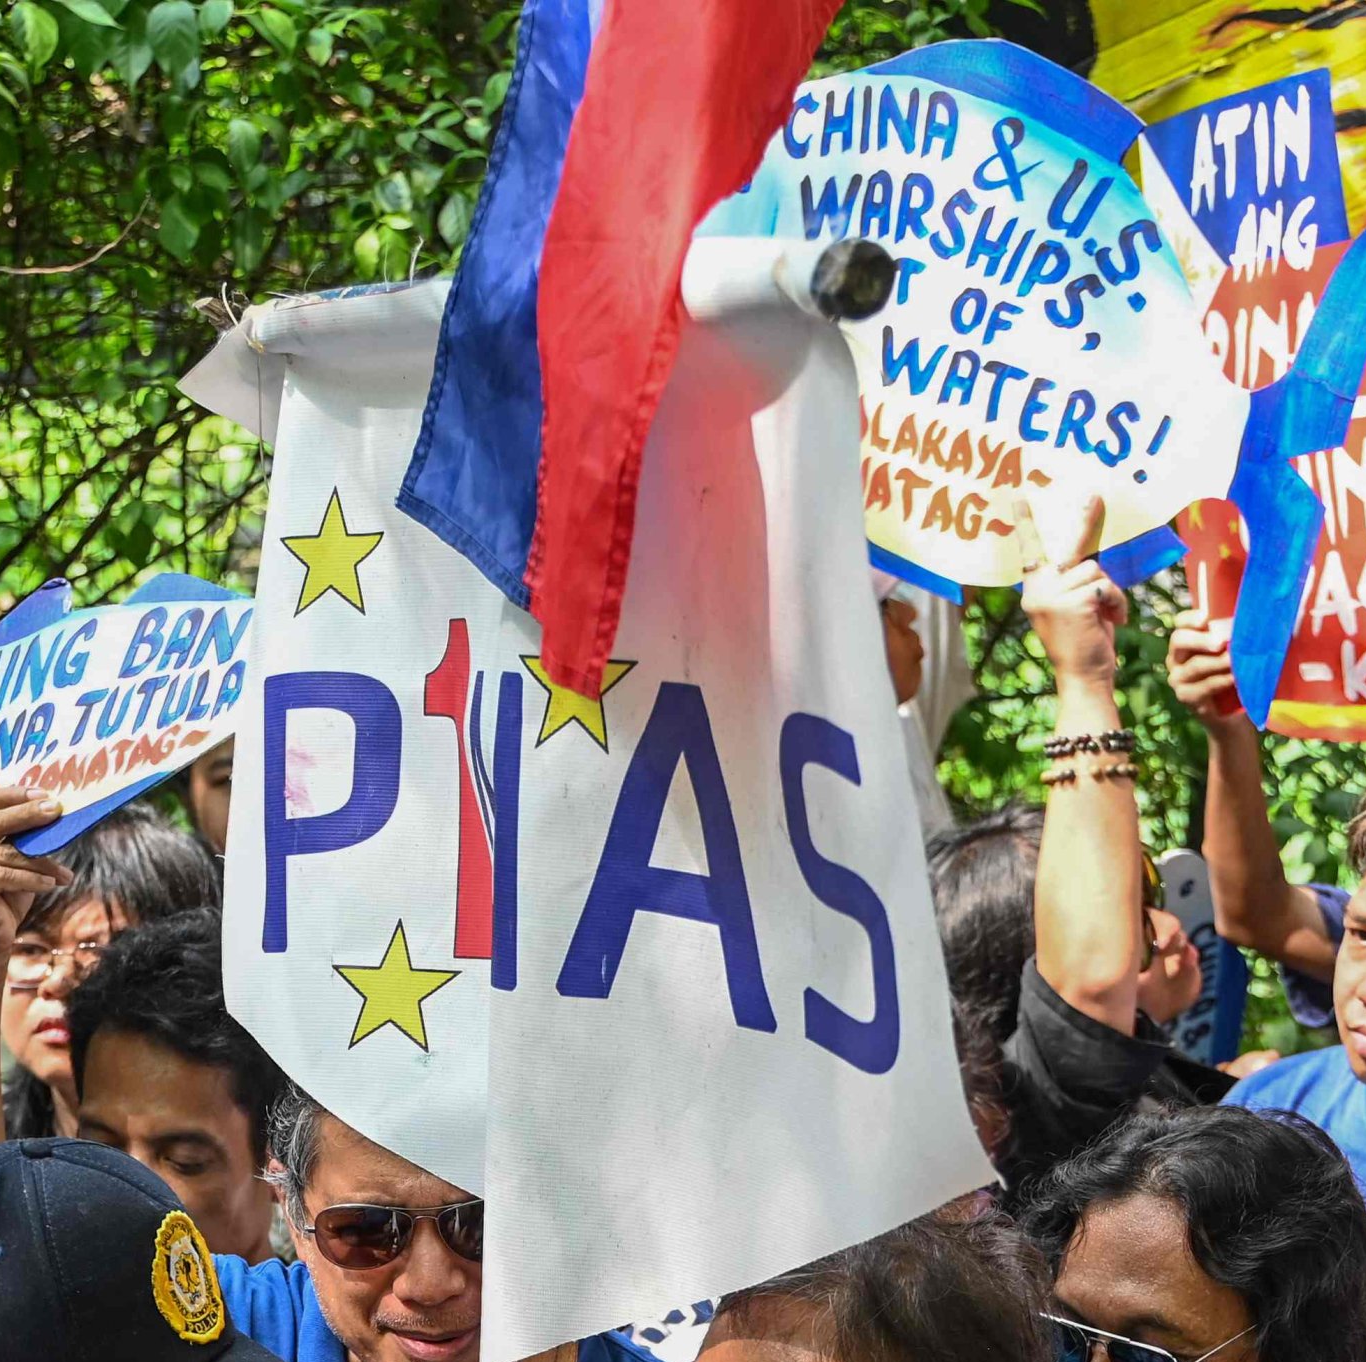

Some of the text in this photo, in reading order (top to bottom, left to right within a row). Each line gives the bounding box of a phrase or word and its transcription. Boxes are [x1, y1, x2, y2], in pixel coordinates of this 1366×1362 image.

[783, 83, 1163, 314] CHINA & U.S.
[1190, 84, 1311, 217] ATIN
[799, 168, 1107, 352] WARSHIPS,
[1229, 195, 1319, 282] ANG
[950, 286, 1024, 346] OF
[880, 325, 1173, 485] WATERS!
[118, 606, 254, 679] BAN
